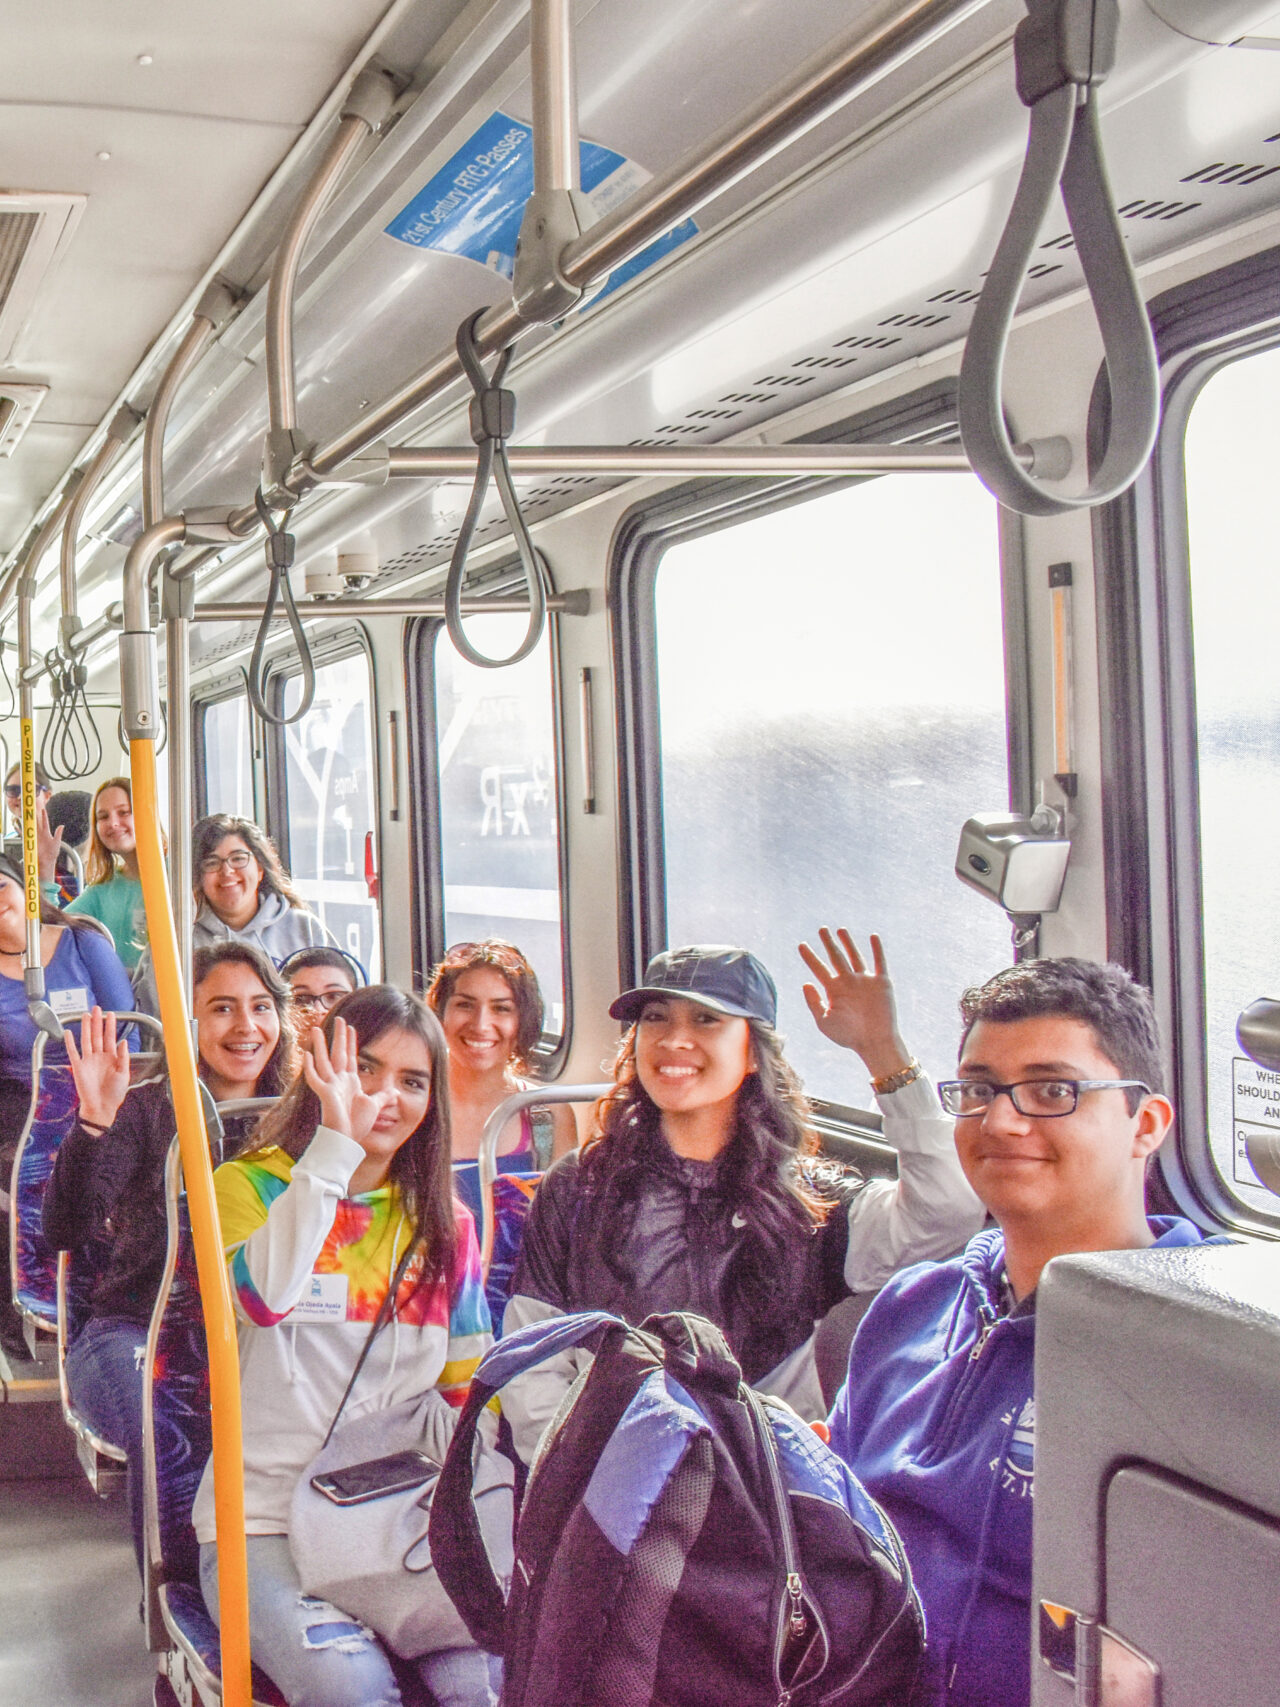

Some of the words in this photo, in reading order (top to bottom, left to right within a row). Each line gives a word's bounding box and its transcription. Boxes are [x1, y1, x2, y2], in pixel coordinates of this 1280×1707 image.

[401, 221, 434, 244] 21st
[420, 187, 473, 223] Century
[453, 164, 489, 191] RTC
[475, 128, 528, 169] Passes
[23, 725, 32, 773] PISE
[25, 781, 35, 820] CON
[26, 827, 37, 913] CUIDADO
[1237, 1084, 1280, 1101] SHOULD
